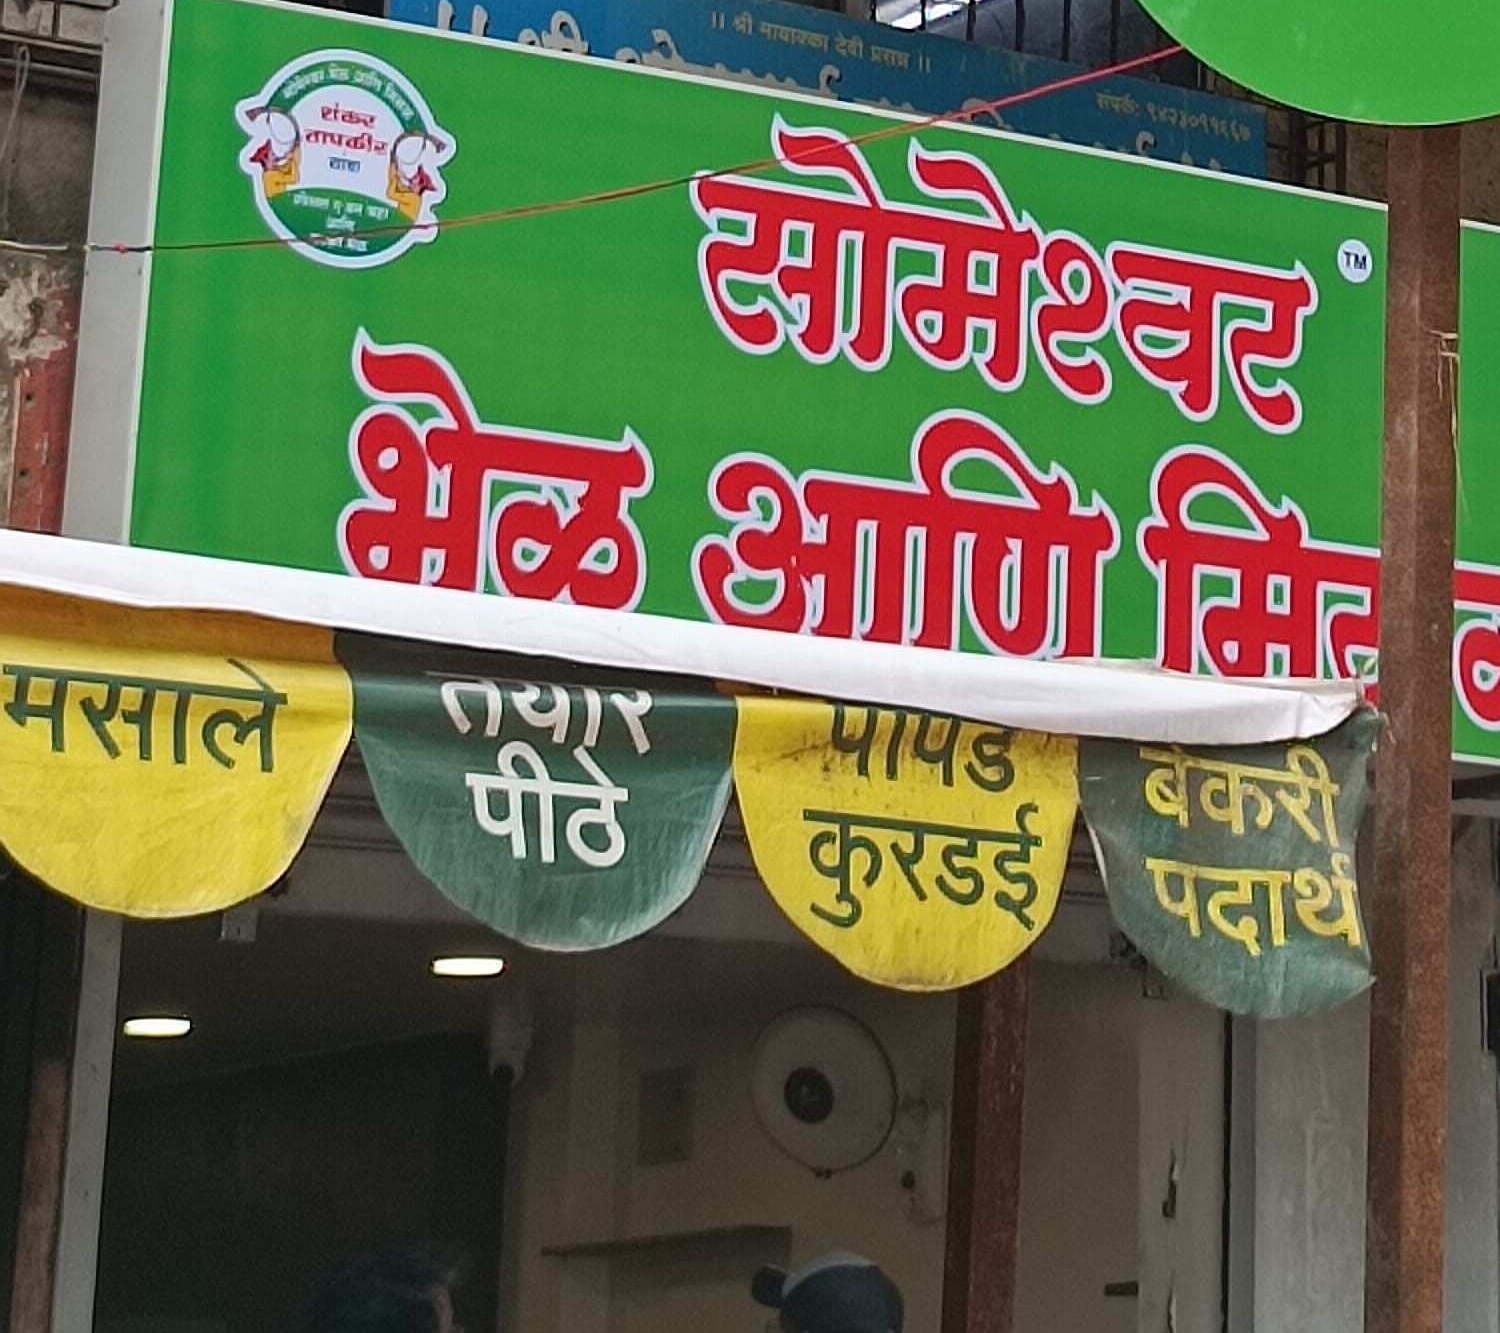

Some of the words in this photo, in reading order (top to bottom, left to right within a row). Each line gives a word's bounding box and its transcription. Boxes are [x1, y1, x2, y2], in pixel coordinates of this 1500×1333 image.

[734, 12, 753, 35] श्री
[835, 31, 864, 59] देवी
[303, 128, 389, 155] तापकीर
[320, 102, 377, 129] शंकर
[689, 112, 1318, 435] सोमेश्वर
[1343, 249, 1367, 270] TM
[338, 327, 656, 612] भेळ
[691, 409, 1121, 661] आणि
[2, 657, 288, 774] मसाले
[465, 739, 629, 868] पीठे
[803, 801, 1043, 931] कुरडई
[1144, 852, 1362, 958] पदार्थ
